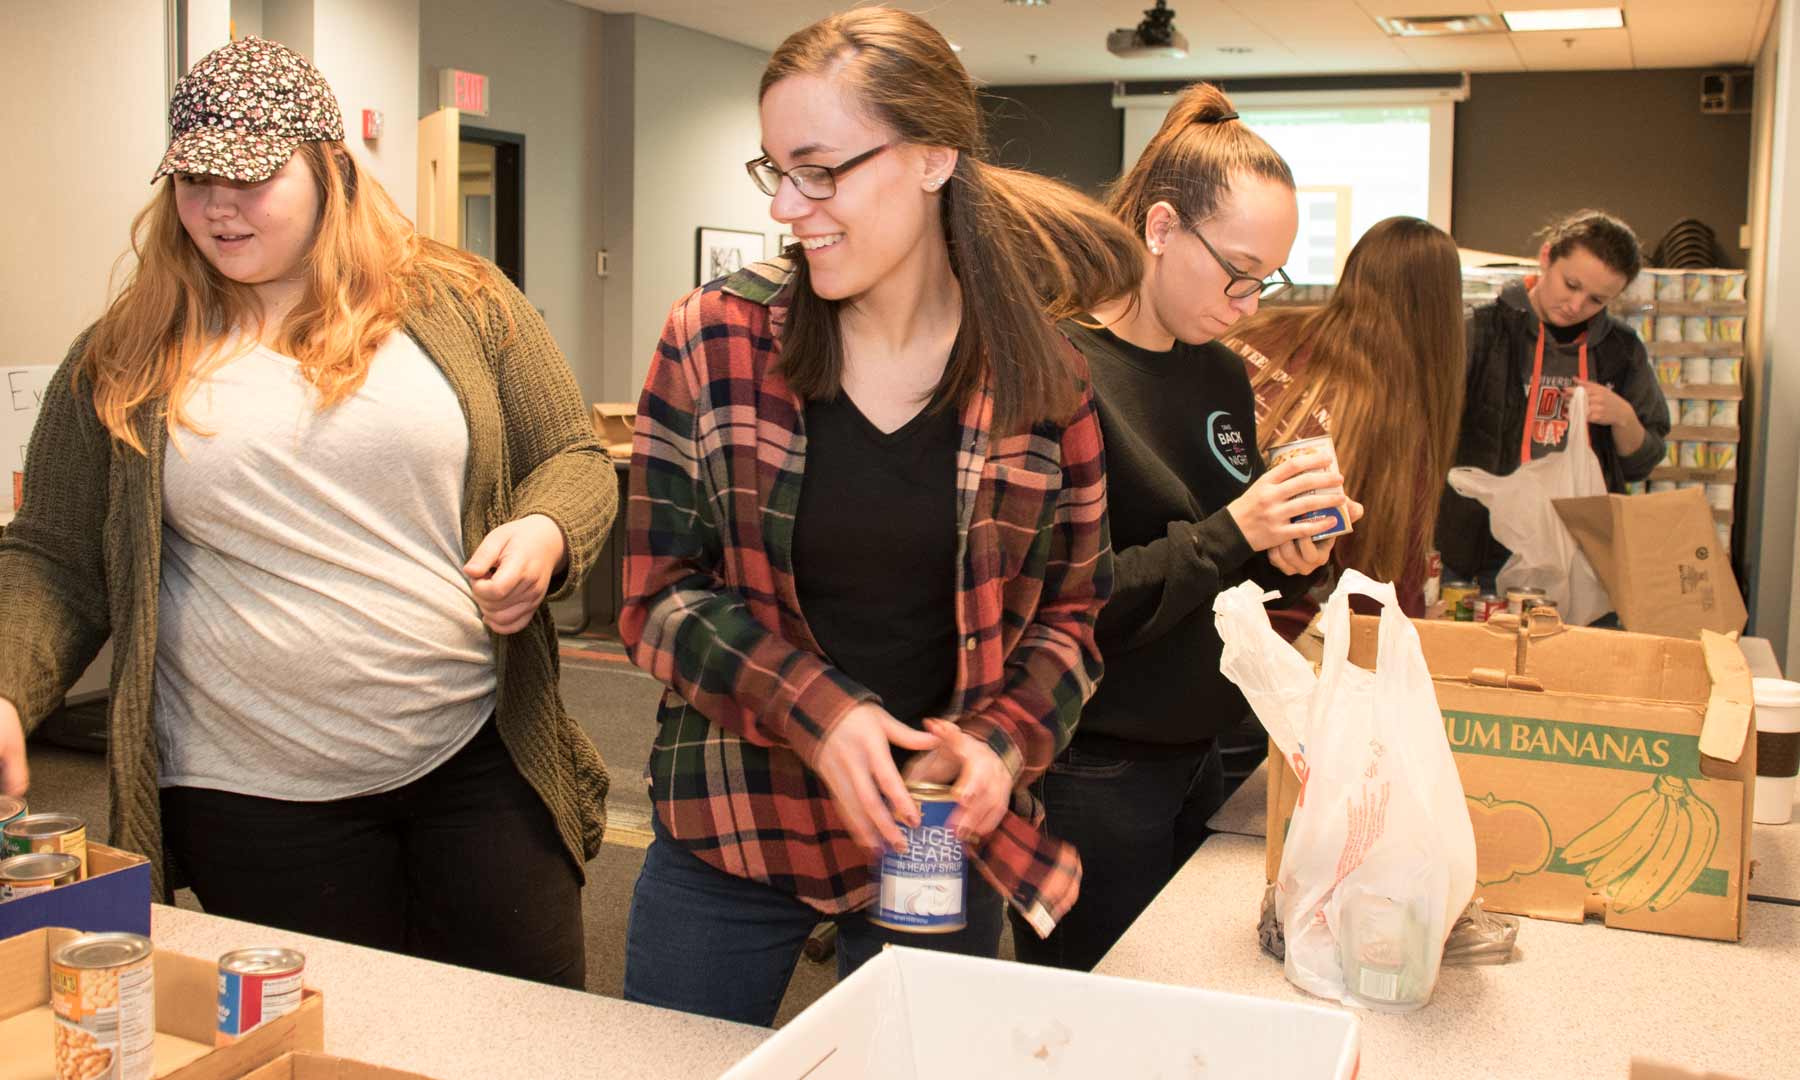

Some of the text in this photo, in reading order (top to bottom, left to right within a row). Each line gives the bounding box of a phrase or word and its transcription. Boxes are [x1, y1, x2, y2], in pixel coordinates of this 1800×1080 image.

[455, 71, 484, 112] EXIT
[1217, 431, 1243, 446] BACK
[1510, 723, 1670, 768] BANANAS
[899, 827, 962, 846] LICE
[903, 845, 962, 862] EARS
[907, 863, 937, 872] HEAVY
